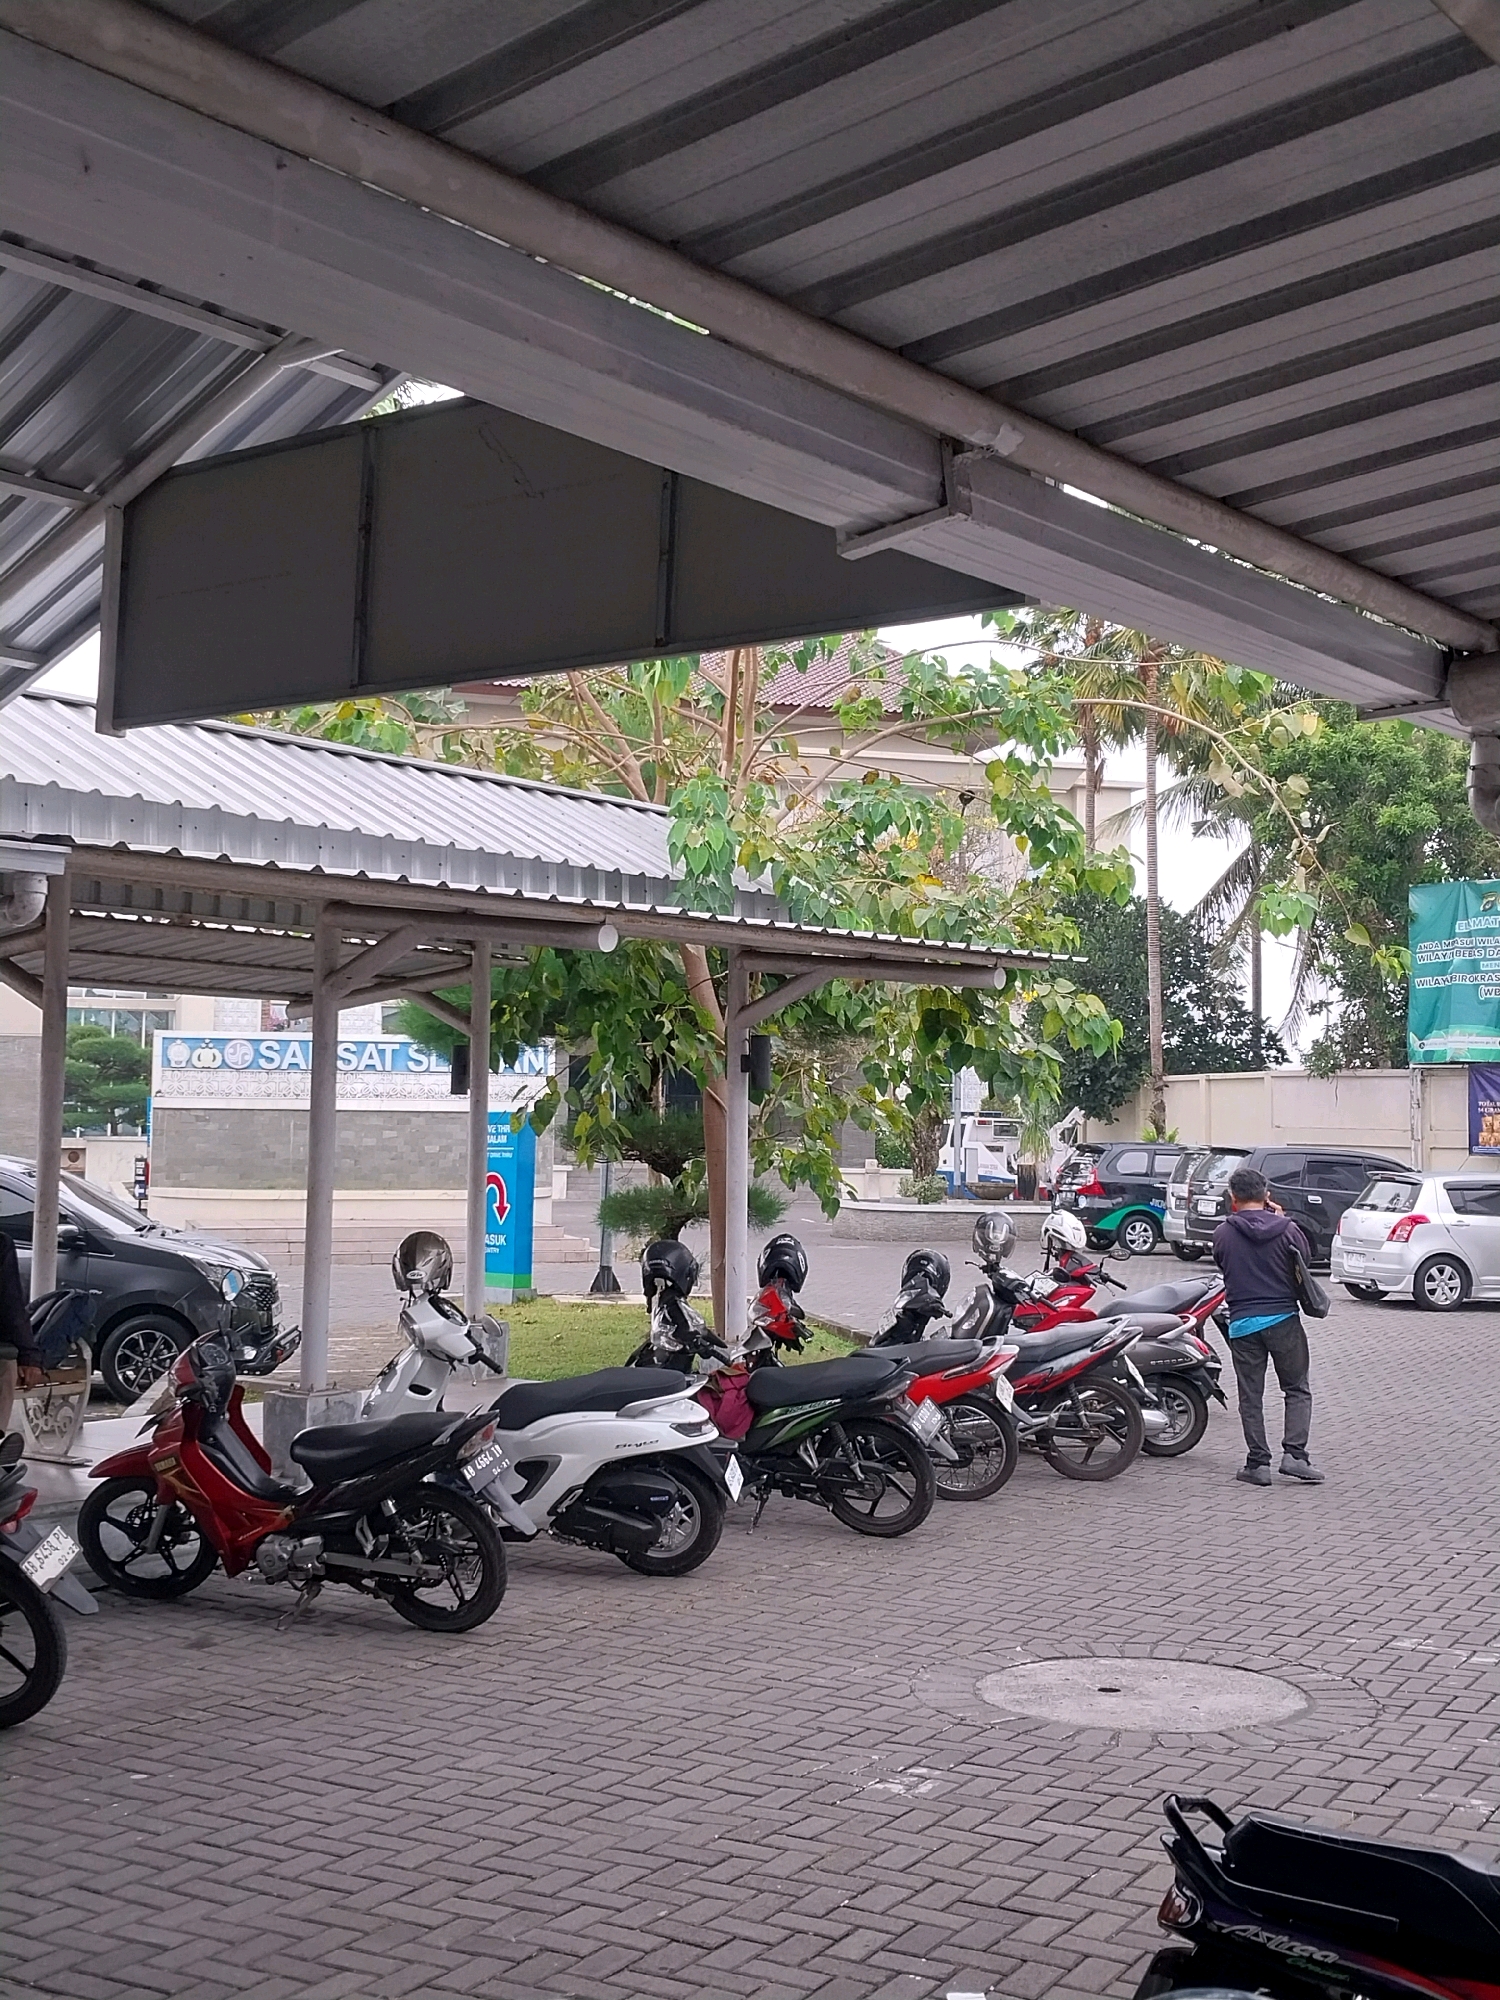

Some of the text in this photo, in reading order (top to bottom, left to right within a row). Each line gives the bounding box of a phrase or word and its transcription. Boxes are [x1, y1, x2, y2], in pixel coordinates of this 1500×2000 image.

[1417, 942, 1440, 951] ANDA
[258, 1041, 544, 1073] SASAT SLAN
[497, 1125, 510, 1133] THR
[485, 1234, 506, 1246] ASUK
[463, 1466, 476, 1480] AB
[23, 1560, 39, 1577] AB
[1221, 1924, 1339, 1964] Astrea
